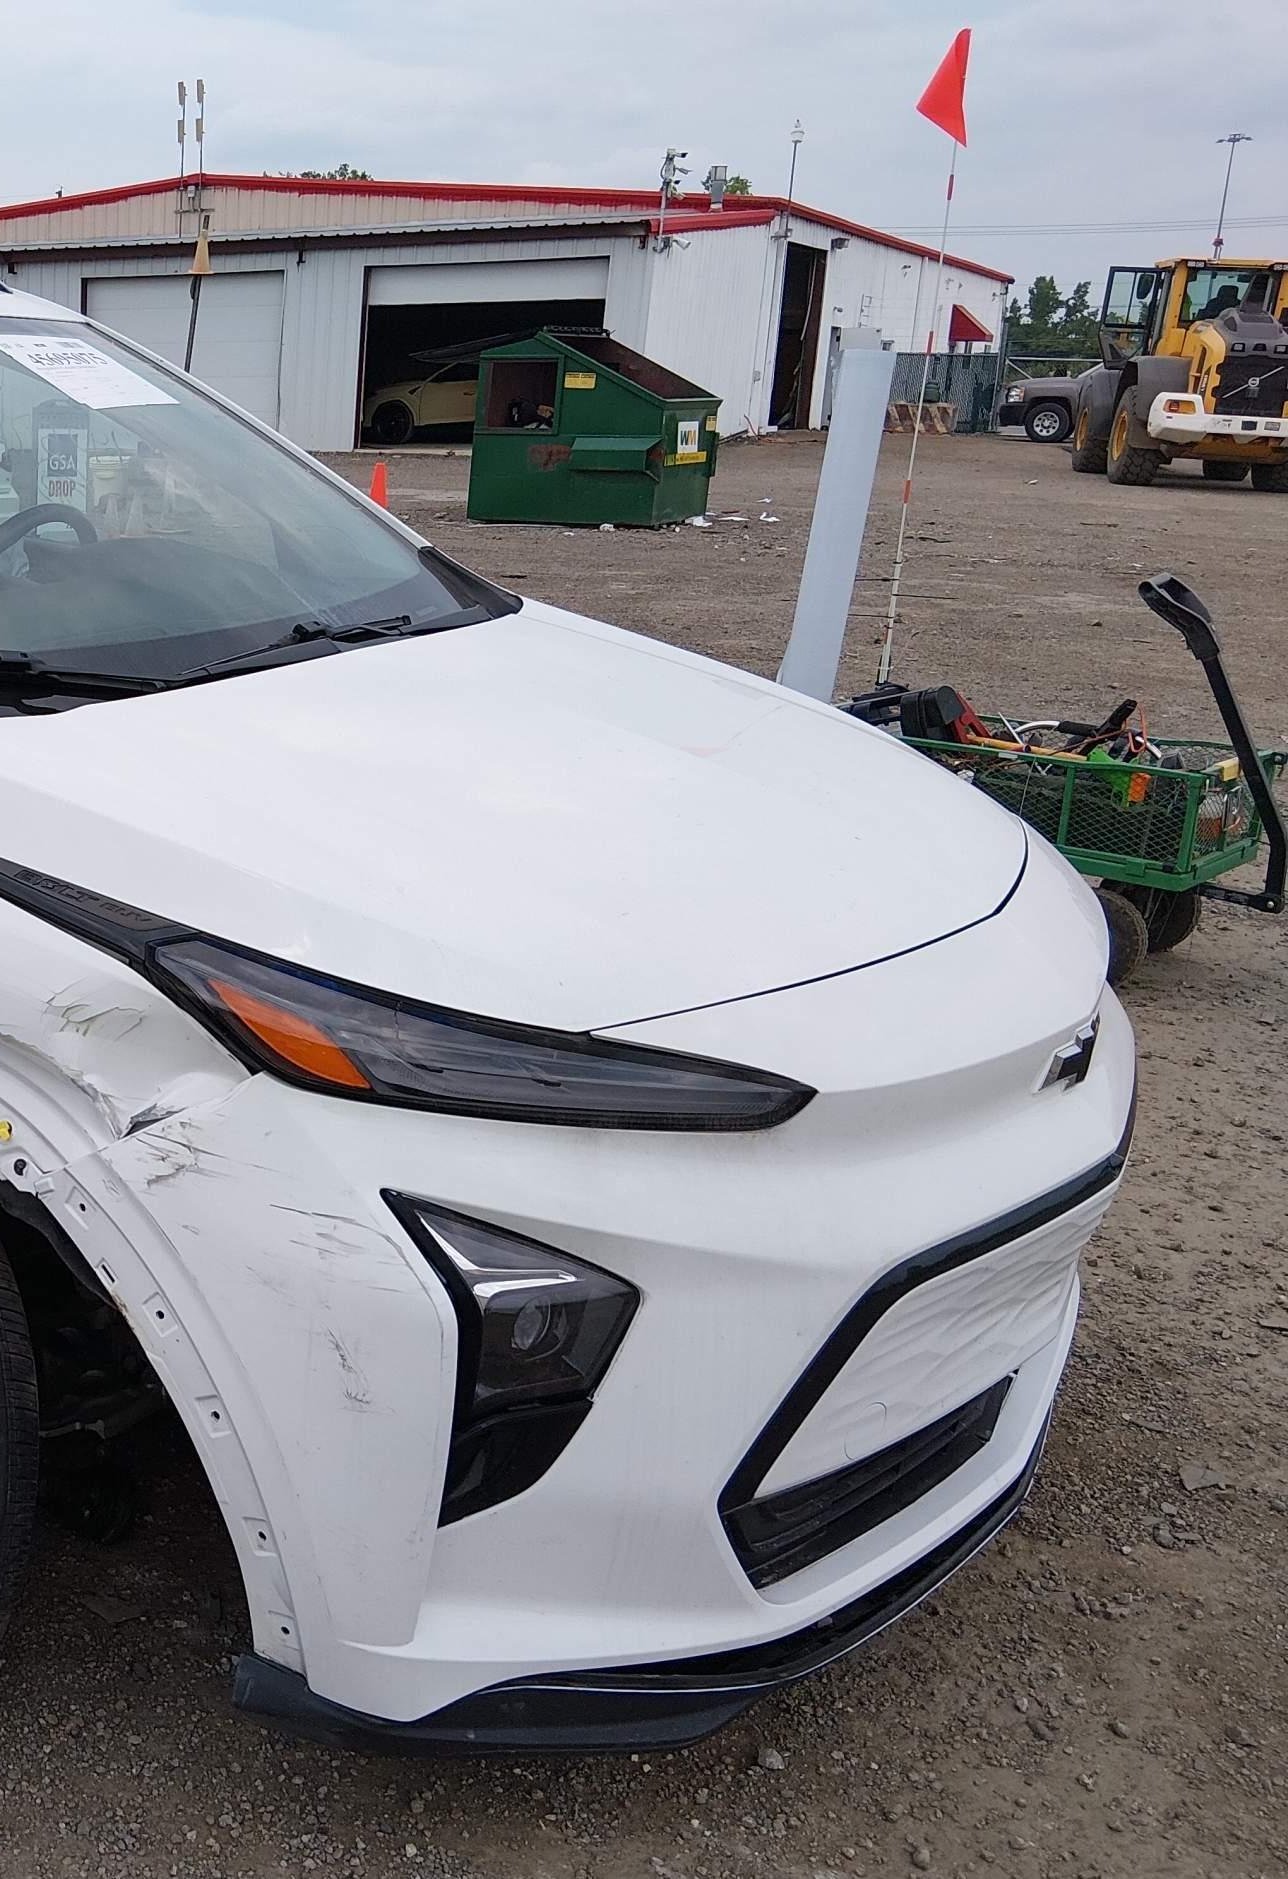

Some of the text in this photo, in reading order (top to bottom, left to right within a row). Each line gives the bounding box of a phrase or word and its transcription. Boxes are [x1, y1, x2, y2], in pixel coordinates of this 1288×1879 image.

[26, 352, 109, 367] 45695075
[680, 429, 697, 446] WM
[49, 454, 76, 471] GSA
[48, 480, 76, 497] DROP
